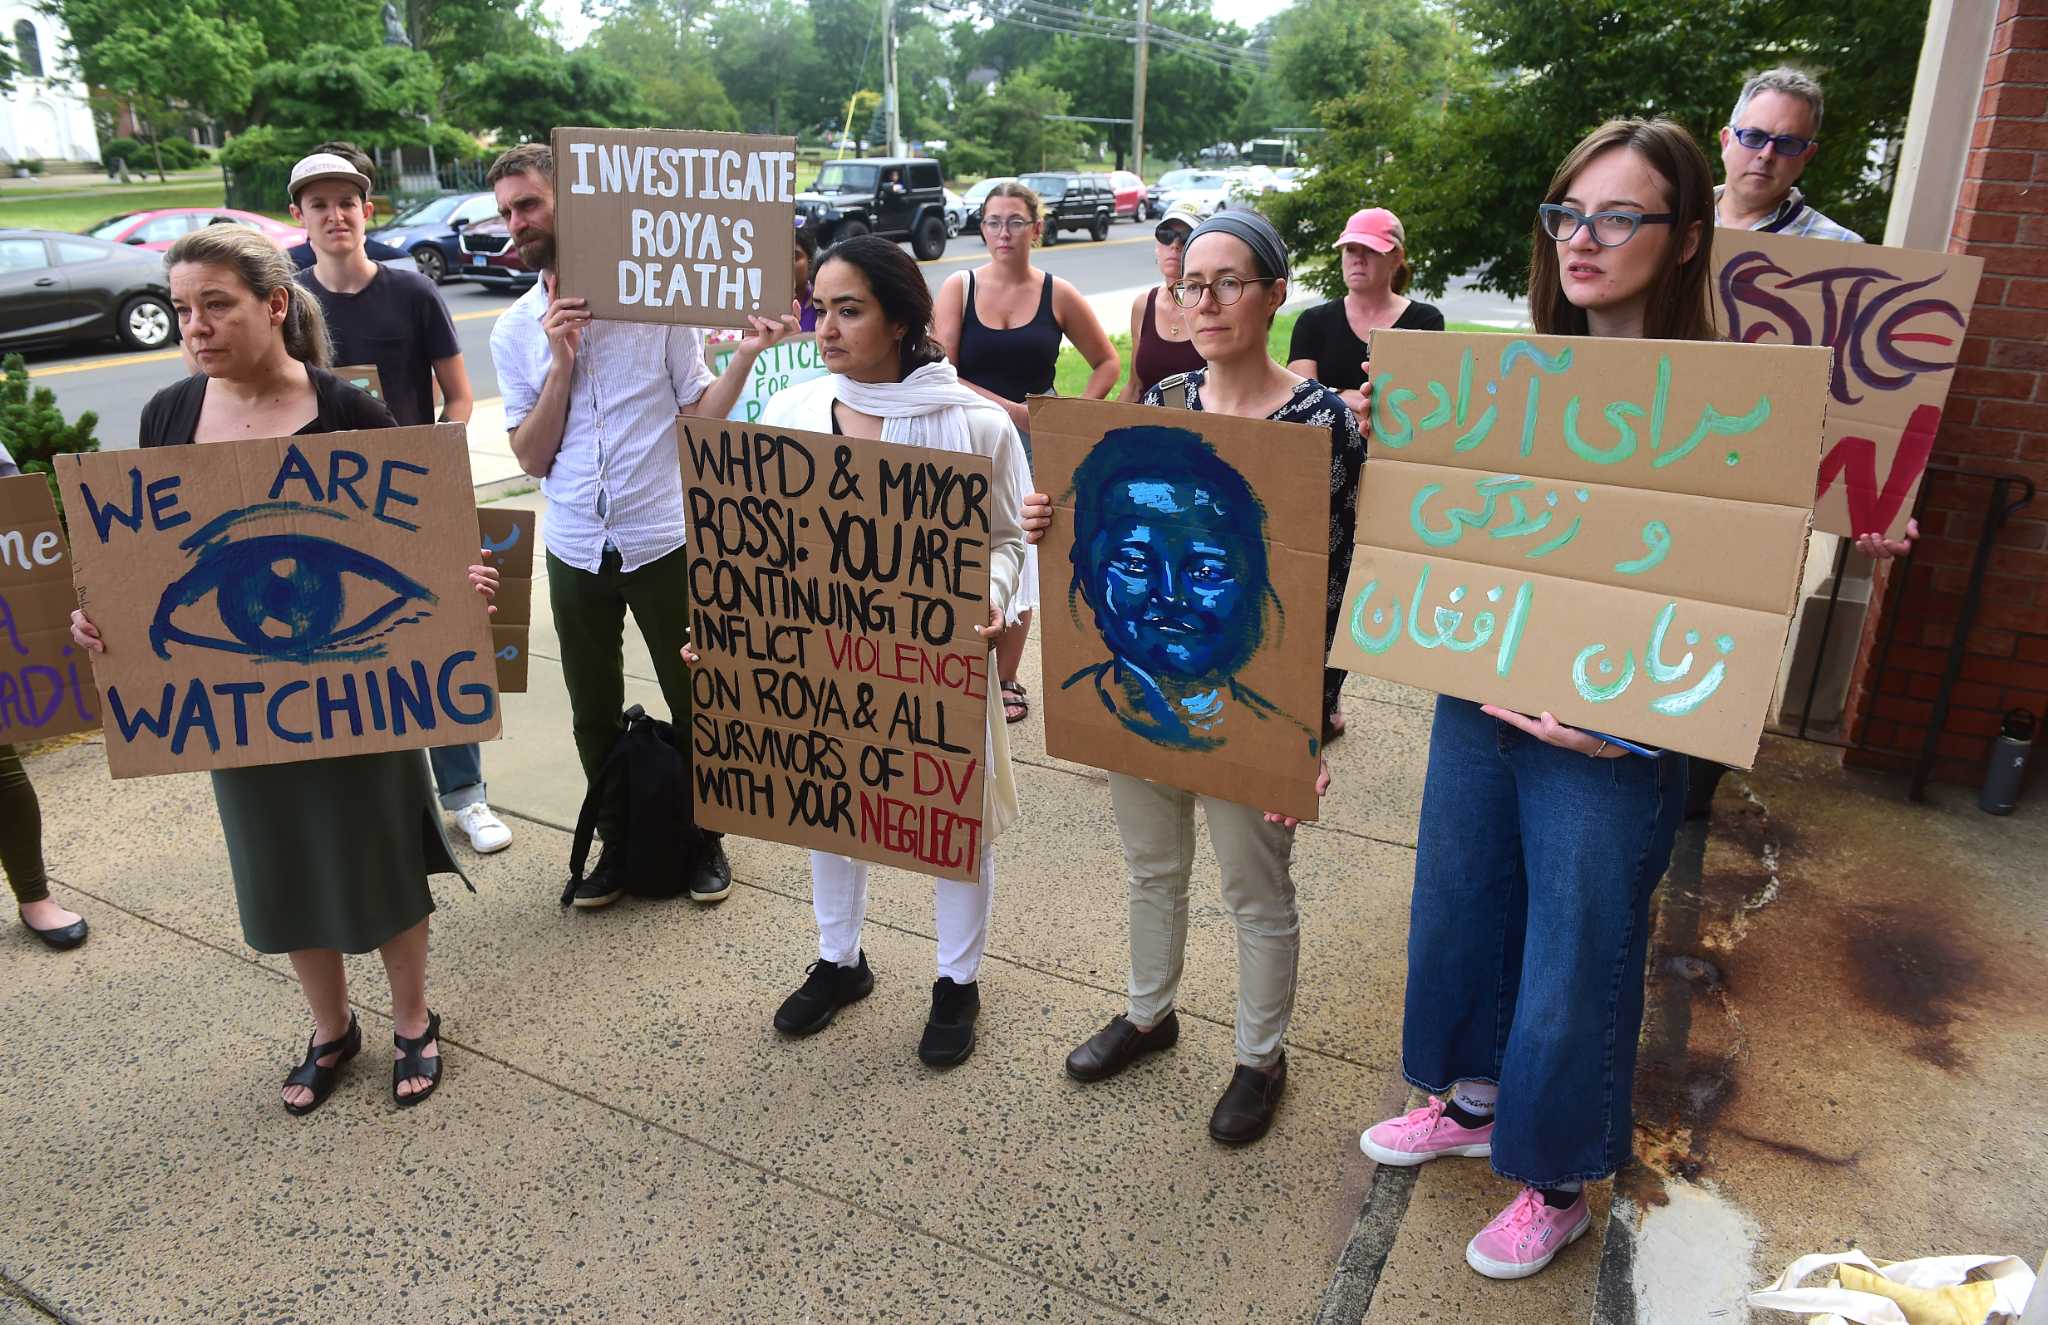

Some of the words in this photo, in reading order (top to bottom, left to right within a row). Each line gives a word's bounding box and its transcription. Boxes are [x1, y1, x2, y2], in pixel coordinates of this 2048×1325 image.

[569, 143, 795, 203] INVESTIGATE
[631, 208, 754, 263] ROYA'S
[618, 260, 762, 310] DEATH!
[714, 341, 826, 377] JSTICE
[755, 374, 790, 398] FOR
[79, 465, 191, 544] WE
[267, 443, 429, 532] ARE
[684, 424, 816, 498] WHPD
[828, 444, 865, 502] &
[878, 458, 990, 534] MAYOR
[688, 486, 810, 573] ROSSI:
[818, 505, 903, 583] YOU
[908, 524, 984, 601] ARE
[688, 557, 896, 636] CONTINUING
[900, 591, 956, 647] TO
[692, 607, 813, 669] INFLICT
[825, 628, 988, 701] VIOLENCE
[107, 650, 494, 756] WATCHING
[692, 667, 740, 713] ON
[752, 668, 850, 731] ROYA
[852, 682, 879, 733] &
[888, 691, 972, 755] ALL
[693, 712, 847, 782] SURVIVORS
[859, 744, 904, 792] OF
[913, 750, 976, 807] DV
[695, 763, 774, 819] WITH
[785, 773, 856, 837] YOUR
[859, 790, 983, 876] NEGLECT
